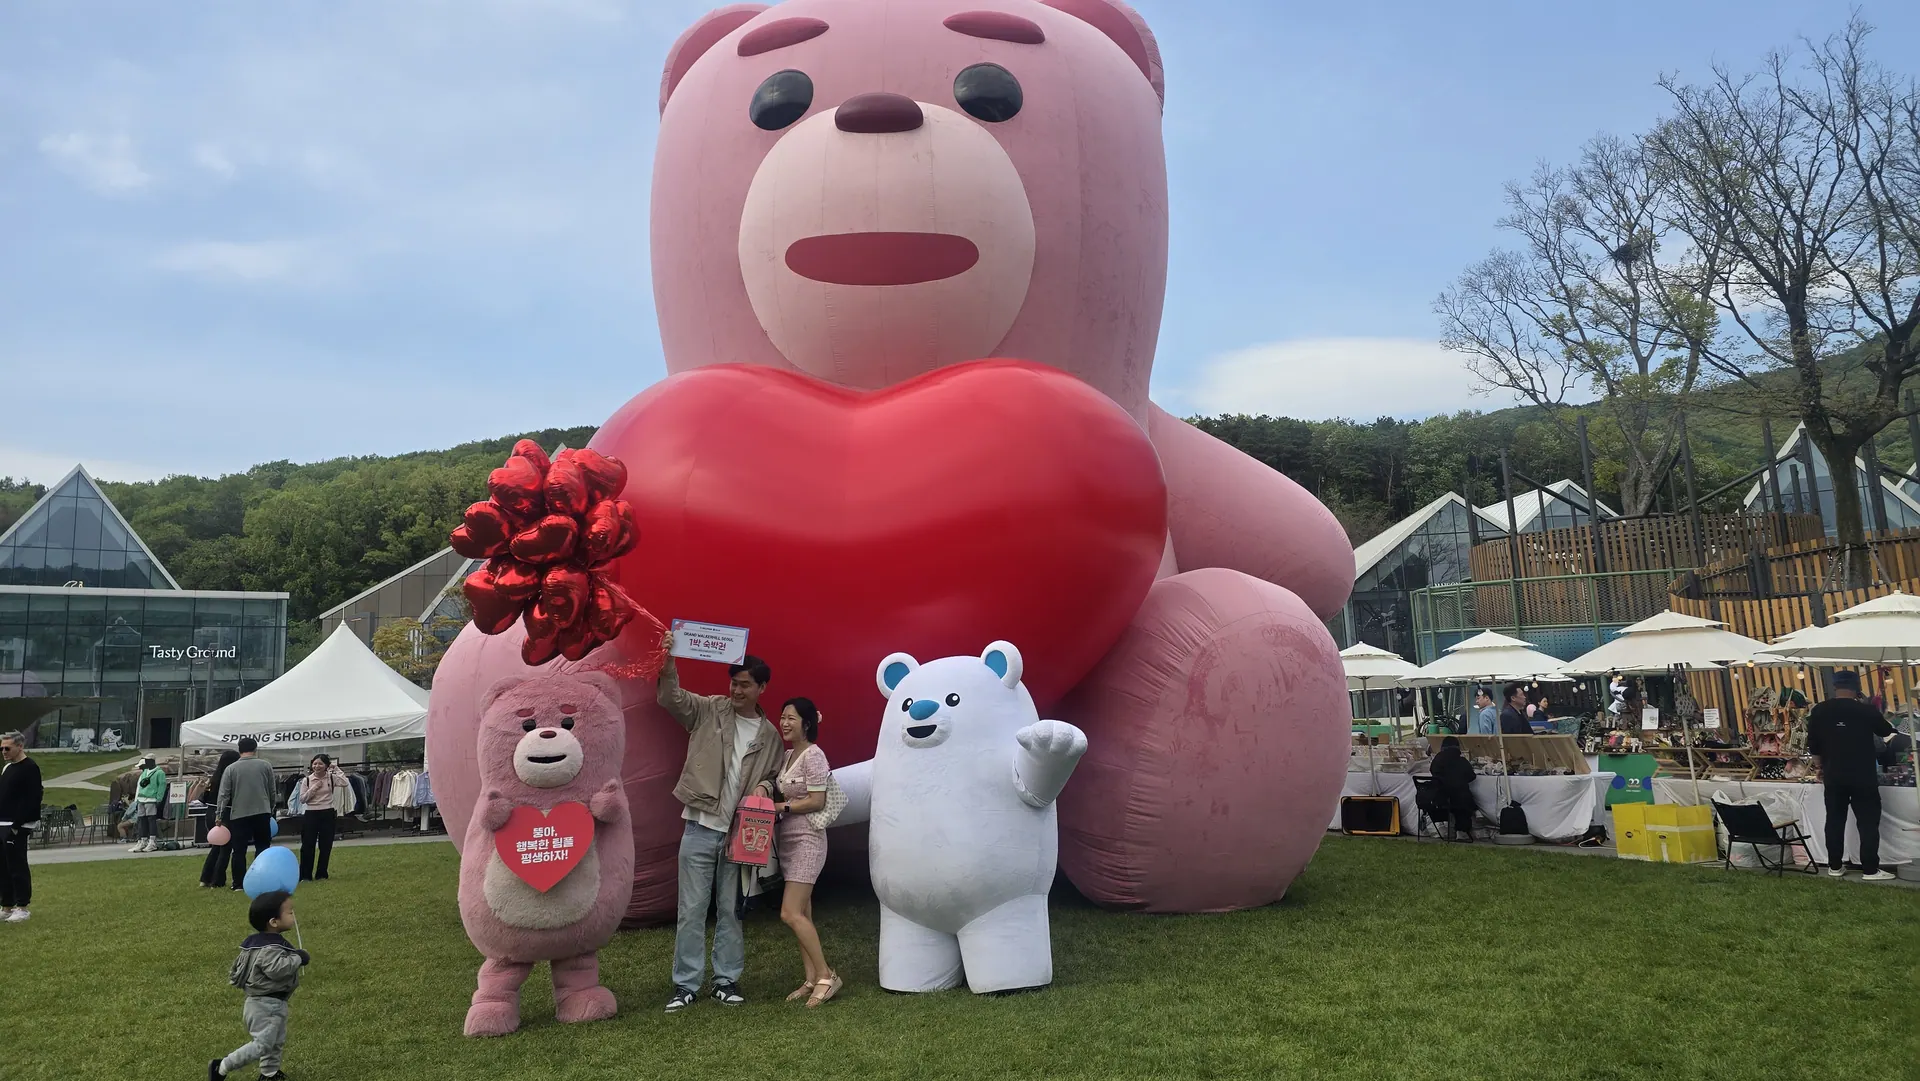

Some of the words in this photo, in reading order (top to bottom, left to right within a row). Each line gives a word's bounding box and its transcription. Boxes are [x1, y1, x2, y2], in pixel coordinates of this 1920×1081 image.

[689, 639, 701, 648] 1박
[703, 640, 726, 651] 숙박권
[148, 645, 185, 661] Tasty
[273, 729, 341, 742] SHOPPING
[344, 726, 387, 738] FESTA
[533, 826, 558, 839] 뚱아,
[516, 838, 550, 852] 행복한
[520, 849, 569, 865] 평생하자!
